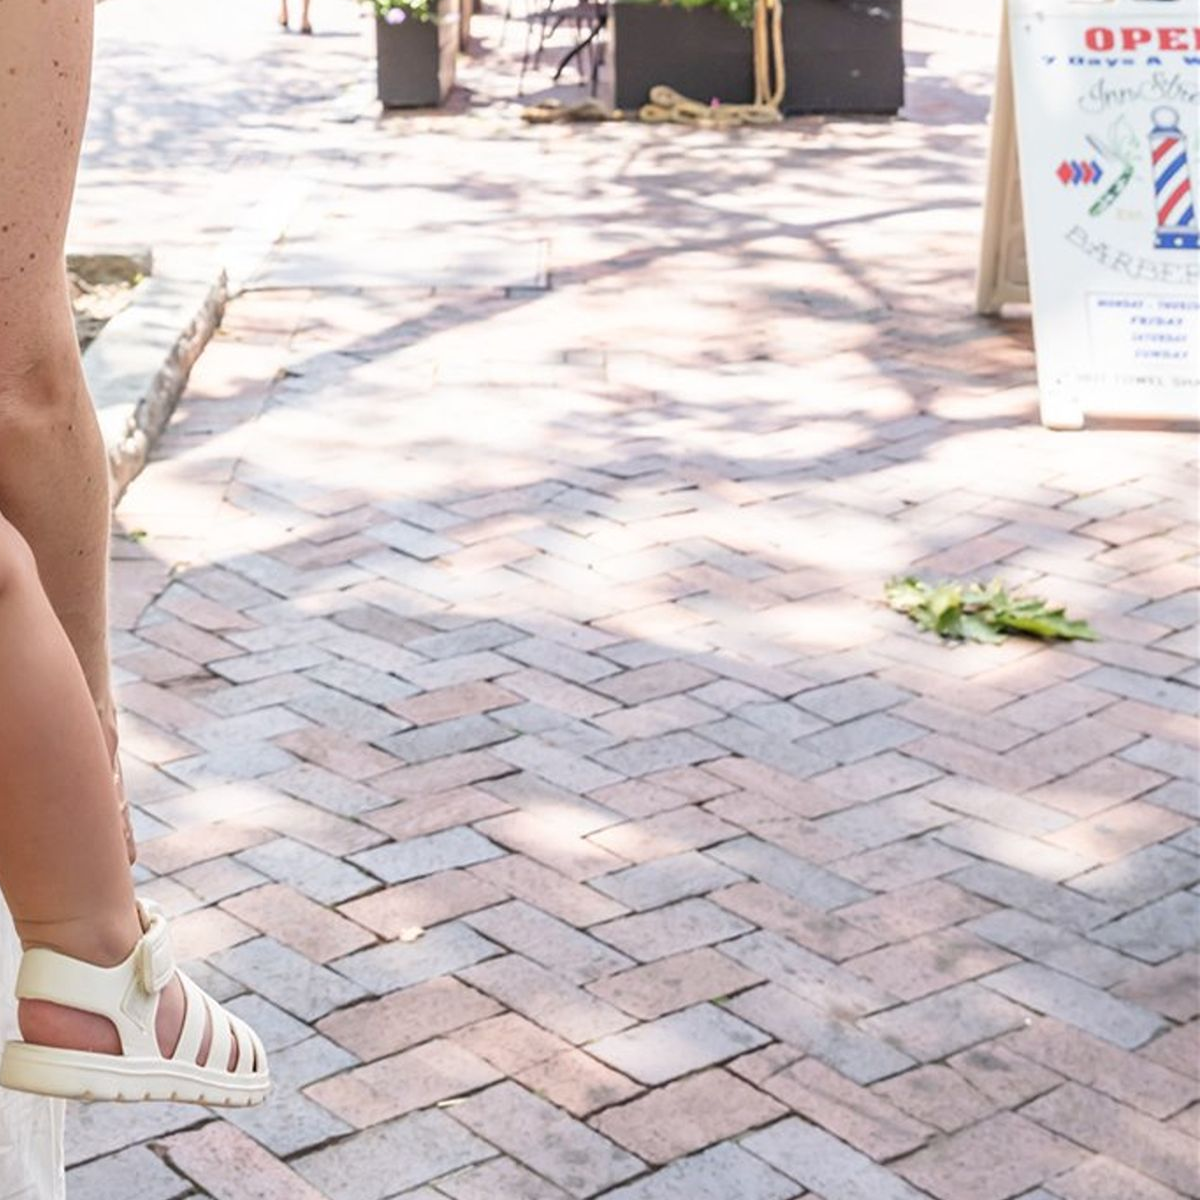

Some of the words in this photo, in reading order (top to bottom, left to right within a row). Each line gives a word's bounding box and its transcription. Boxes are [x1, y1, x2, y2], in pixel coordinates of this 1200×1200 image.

[1085, 26, 1200, 52] OPE
[1068, 56, 1134, 67] Days
[1146, 56, 1161, 65] A
